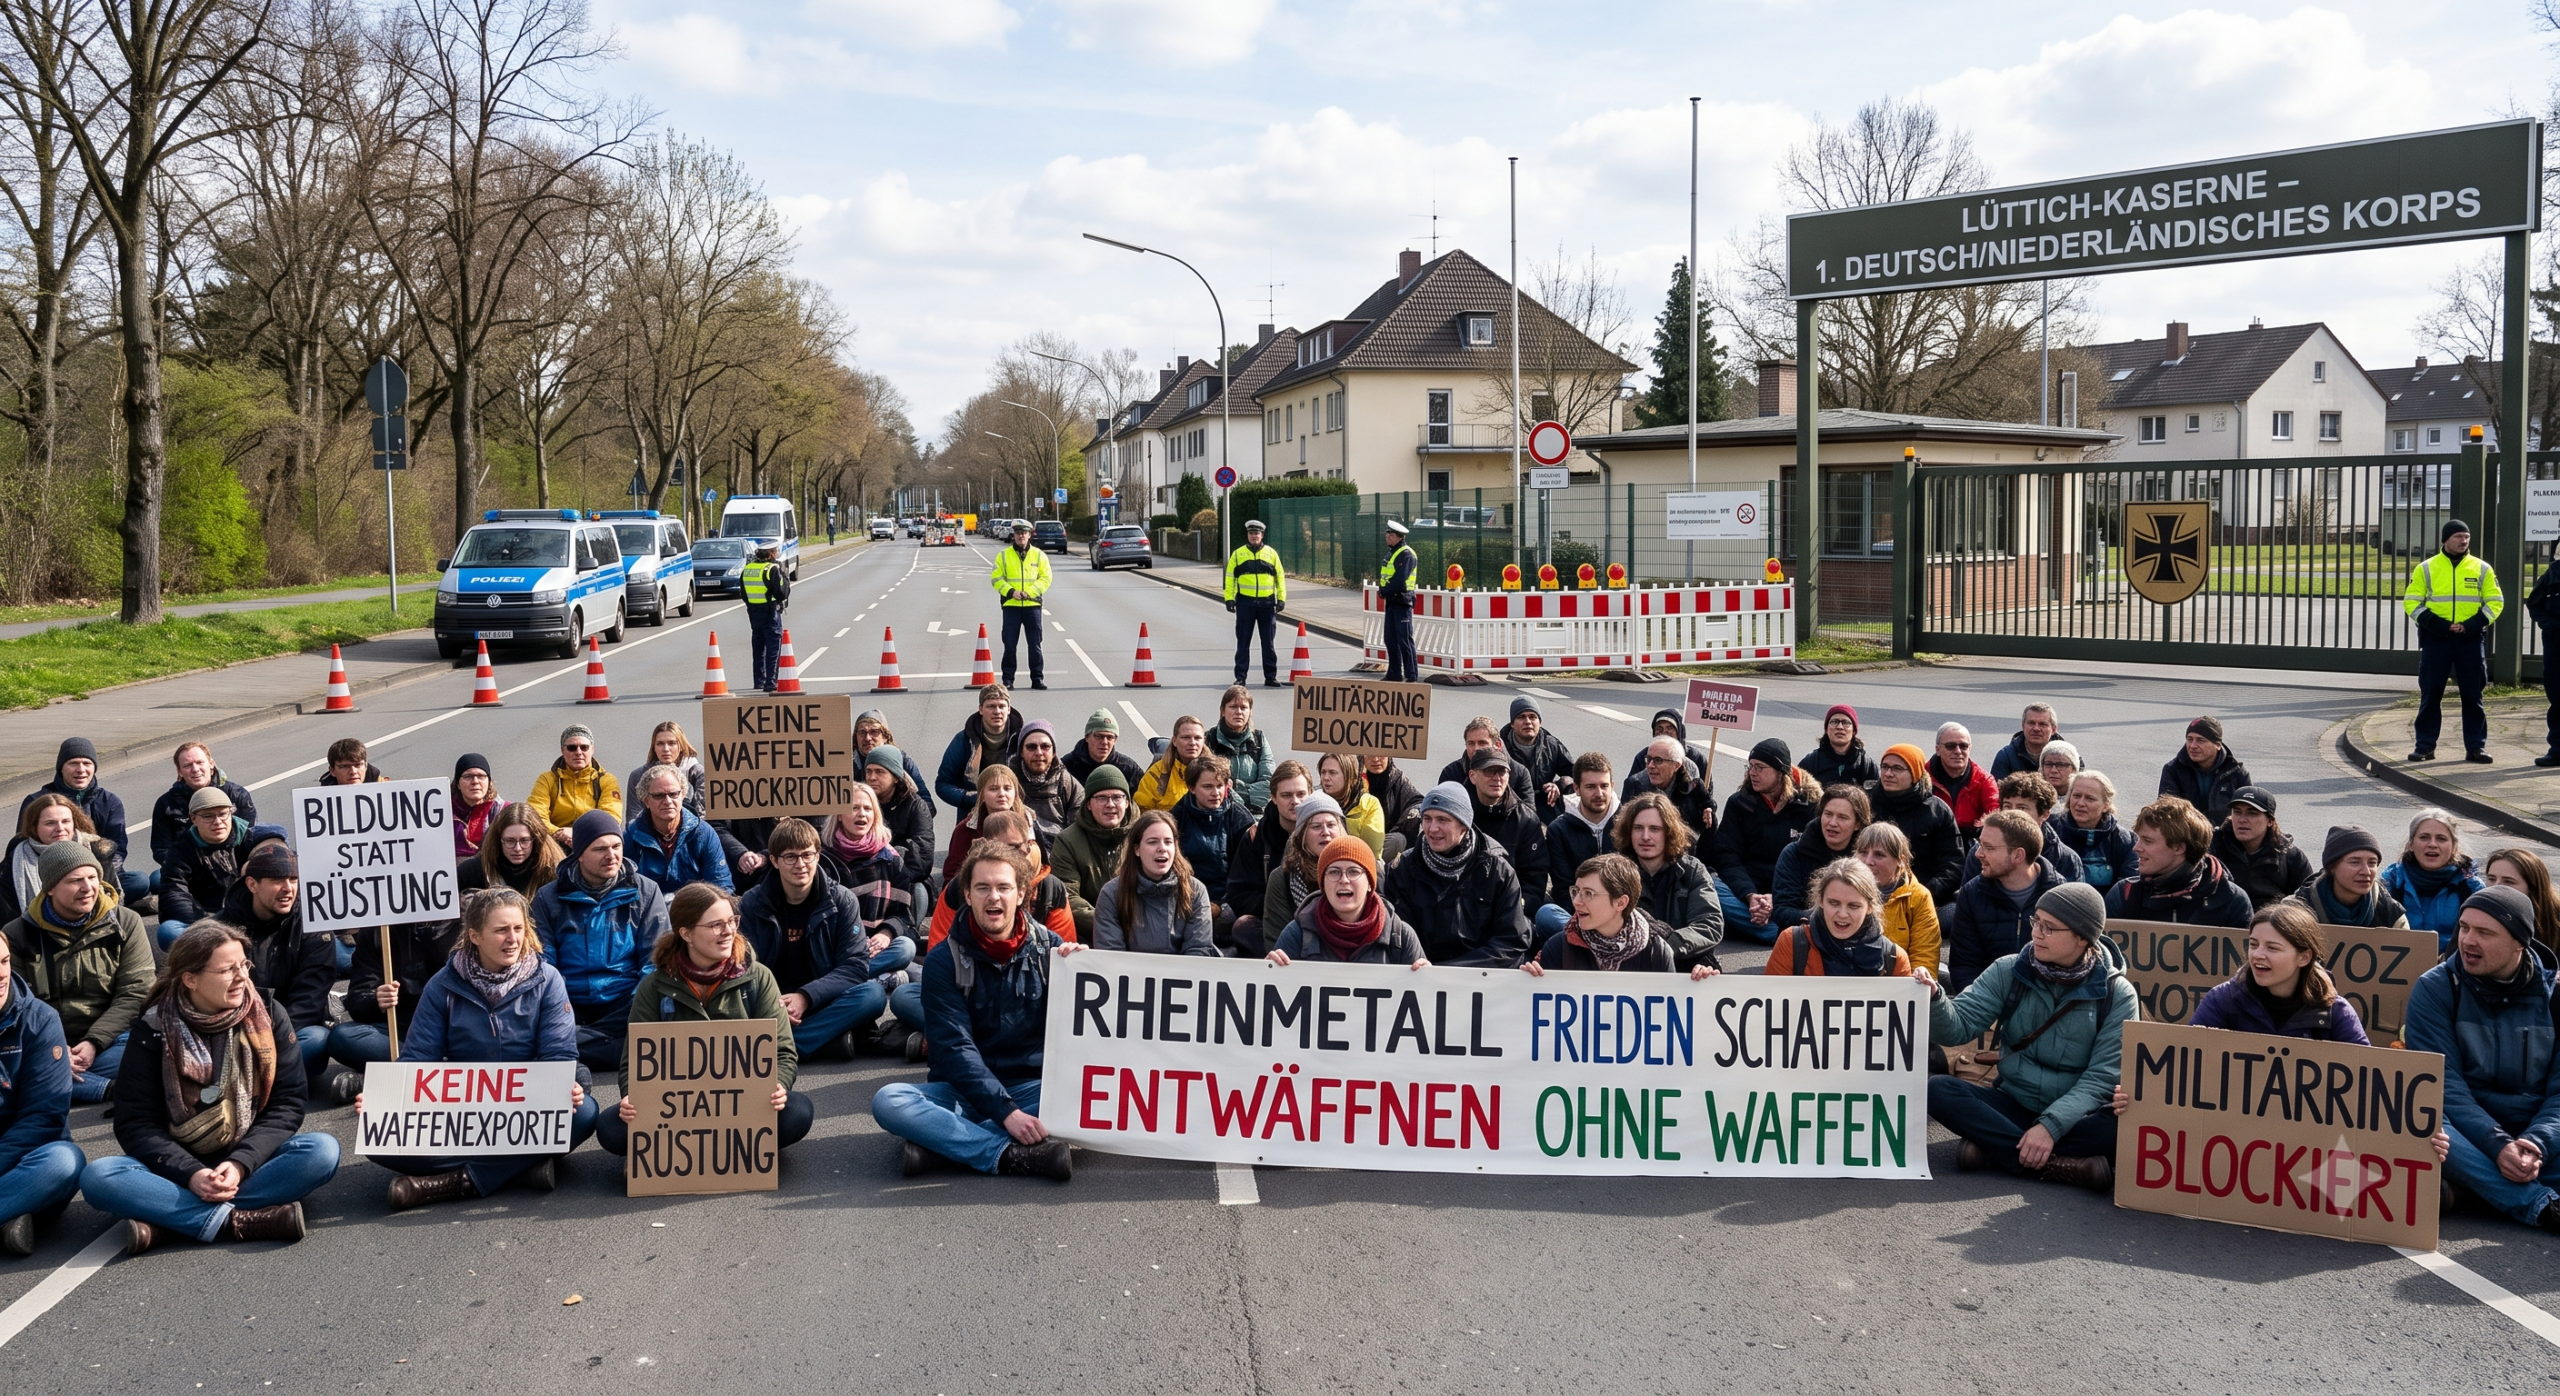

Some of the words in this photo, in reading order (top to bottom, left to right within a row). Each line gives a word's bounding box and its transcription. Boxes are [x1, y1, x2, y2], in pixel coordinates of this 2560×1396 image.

[1962, 169, 2268, 234] LÜTTICH-KASERNE
[1815, 259, 1837, 284] 1.
[1845, 204, 2330, 282] DEUTSCH/NIEDERLÄNDISCHES
[2343, 186, 2482, 231] KORPS
[737, 704, 822, 735] KEINE
[1296, 684, 1425, 719] MILITÄRRING
[1303, 716, 1424, 751] BLOCKIERT
[303, 788, 444, 838] BILDUNG
[337, 838, 415, 869] STATT
[306, 870, 452, 922] RÜSTUNG
[1072, 971, 1504, 1057] RHEINMETALL
[1531, 992, 1694, 1067] FRIEDEN
[1714, 997, 1916, 1072] SCHAFFEN
[636, 1033, 773, 1082] BILDUNG
[413, 1068, 528, 1103] KEINE
[660, 1089, 745, 1119] STATT
[2134, 1042, 2438, 1138] MILITÄRRING
[363, 1109, 570, 1147] WAFFENEXPORTE
[1079, 1062, 1501, 1150] ENTWÄFFNEN
[1535, 1085, 1682, 1161] OHNE
[1705, 1091, 1907, 1168] WAFFEN
[632, 1123, 775, 1179] RÜSTUNG
[2135, 1125, 2433, 1226] BLOCKIERT
